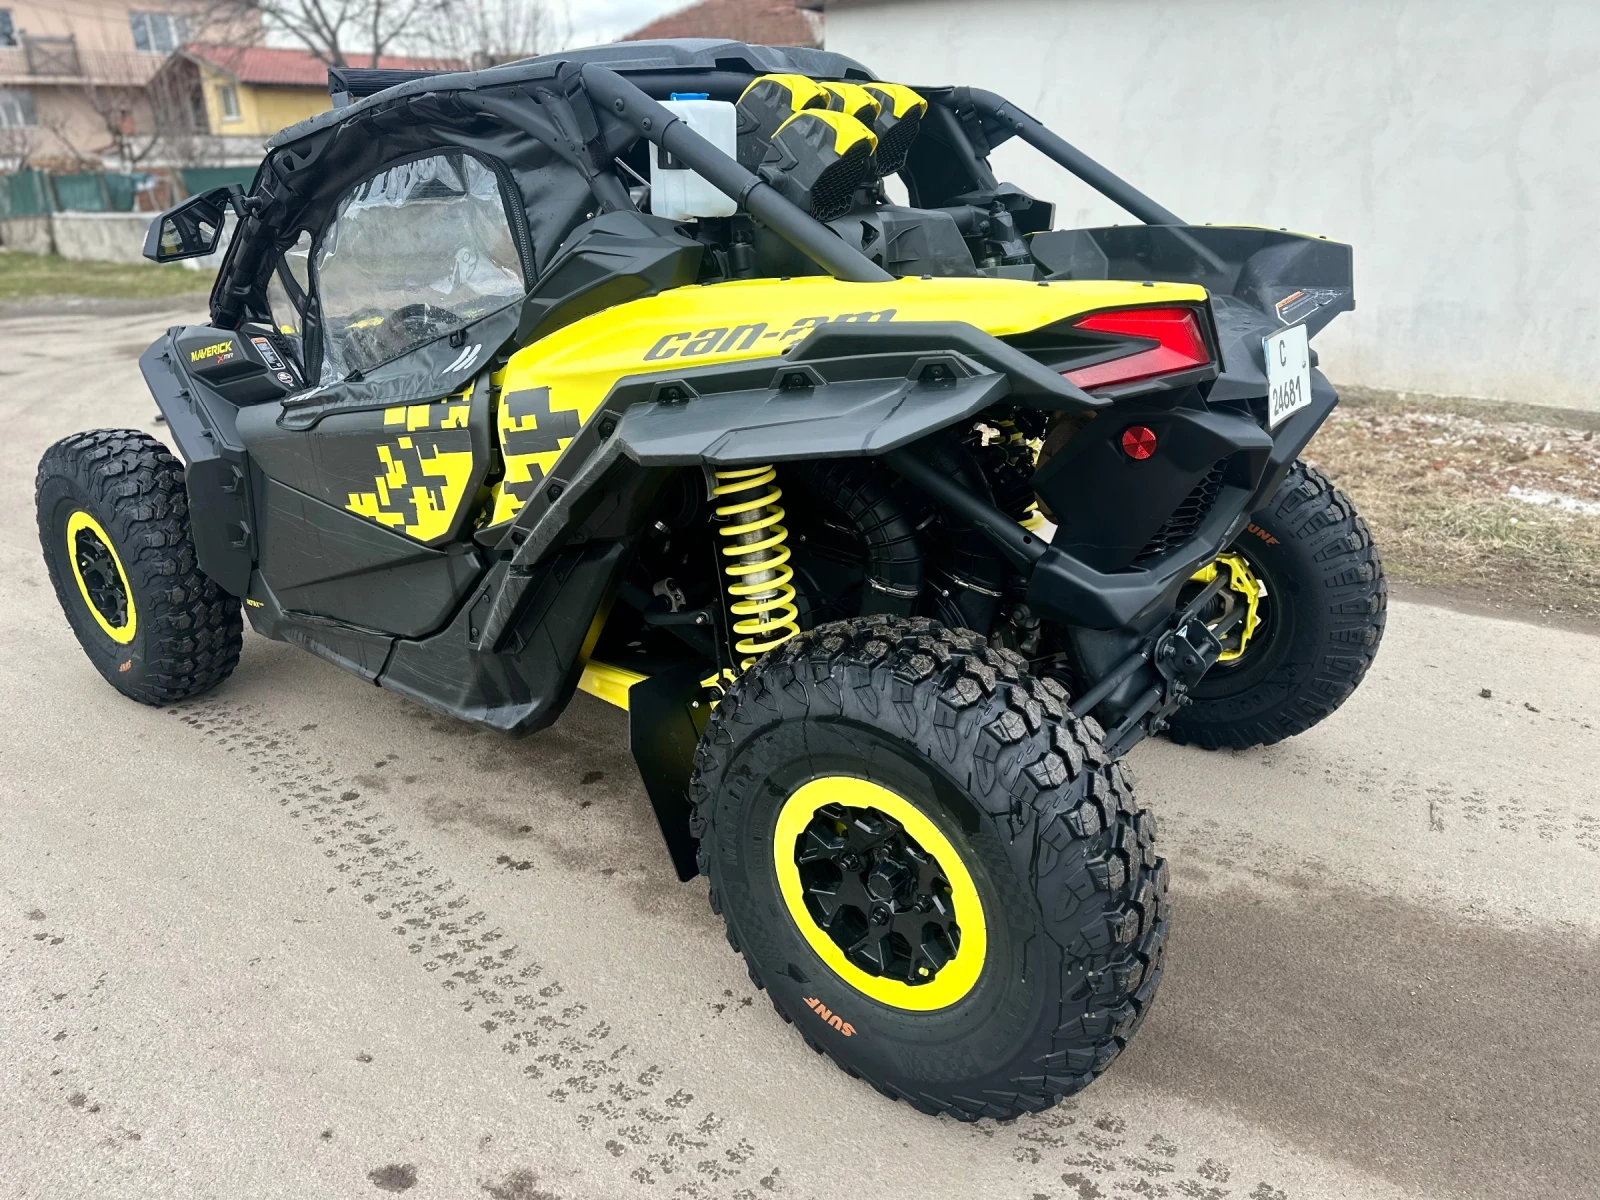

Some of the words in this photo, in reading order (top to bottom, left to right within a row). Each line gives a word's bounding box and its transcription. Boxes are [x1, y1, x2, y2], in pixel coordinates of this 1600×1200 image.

[190, 340, 233, 362] MAVERICK
[1278, 339, 1287, 367] C
[1272, 375, 1302, 417] 24681
[1247, 523, 1281, 546] UNF
[802, 996, 858, 1037] SUNF
